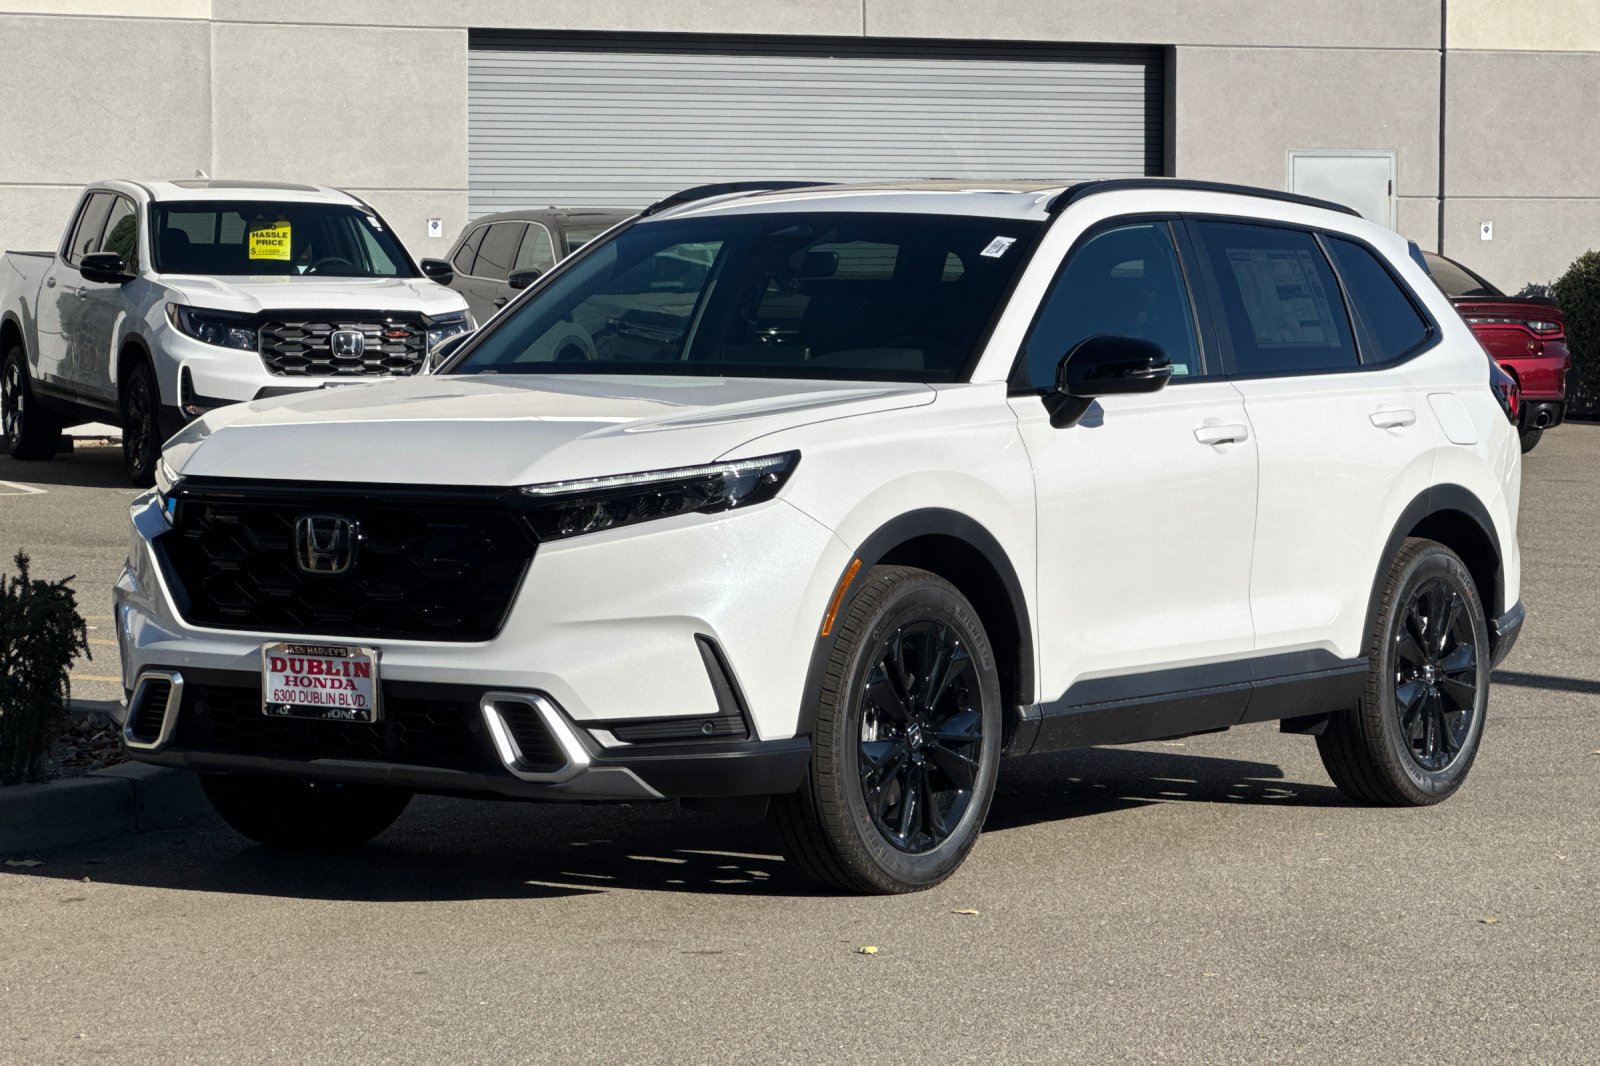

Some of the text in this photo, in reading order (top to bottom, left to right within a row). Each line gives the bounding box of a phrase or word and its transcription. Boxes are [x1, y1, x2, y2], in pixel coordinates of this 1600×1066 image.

[252, 231, 288, 239] HASSLE
[289, 645, 347, 657] KEN HARVEY'S
[269, 656, 371, 679] DUBLIN
[283, 675, 359, 691] HONDA
[273, 688, 369, 708] 6300 DUBLIN BLVD.
